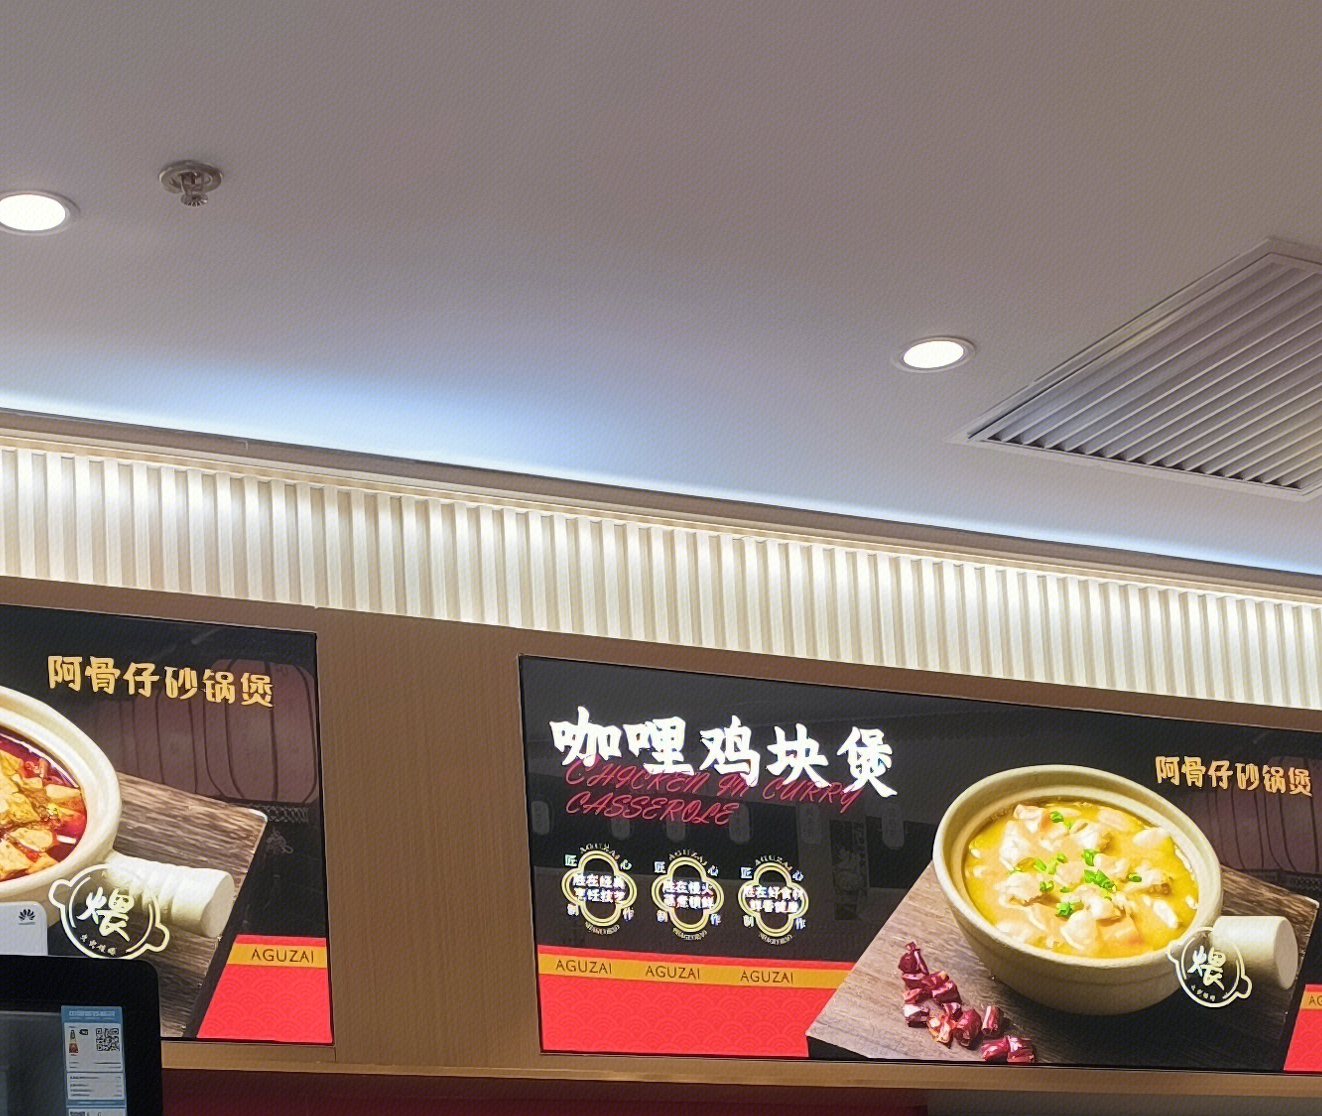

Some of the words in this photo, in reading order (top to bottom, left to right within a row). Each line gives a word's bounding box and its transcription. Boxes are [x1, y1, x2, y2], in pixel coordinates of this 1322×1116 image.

[47, 655, 274, 708] 阿骨仔砂锅煲
[549, 705, 899, 797] 咖哩鸡块煲
[565, 752, 710, 794] CHICKEN
[718, 774, 749, 798] IN
[762, 779, 866, 814] CURRY
[1155, 755, 1313, 797] 阿骨仔砂锅煲
[566, 790, 740, 826] CASSEROLE
[250, 945, 316, 966] AGUZAI
[555, 959, 612, 975] AGUZAI
[645, 965, 701, 980] AGUZAI
[740, 970, 794, 983] AGUZAI
